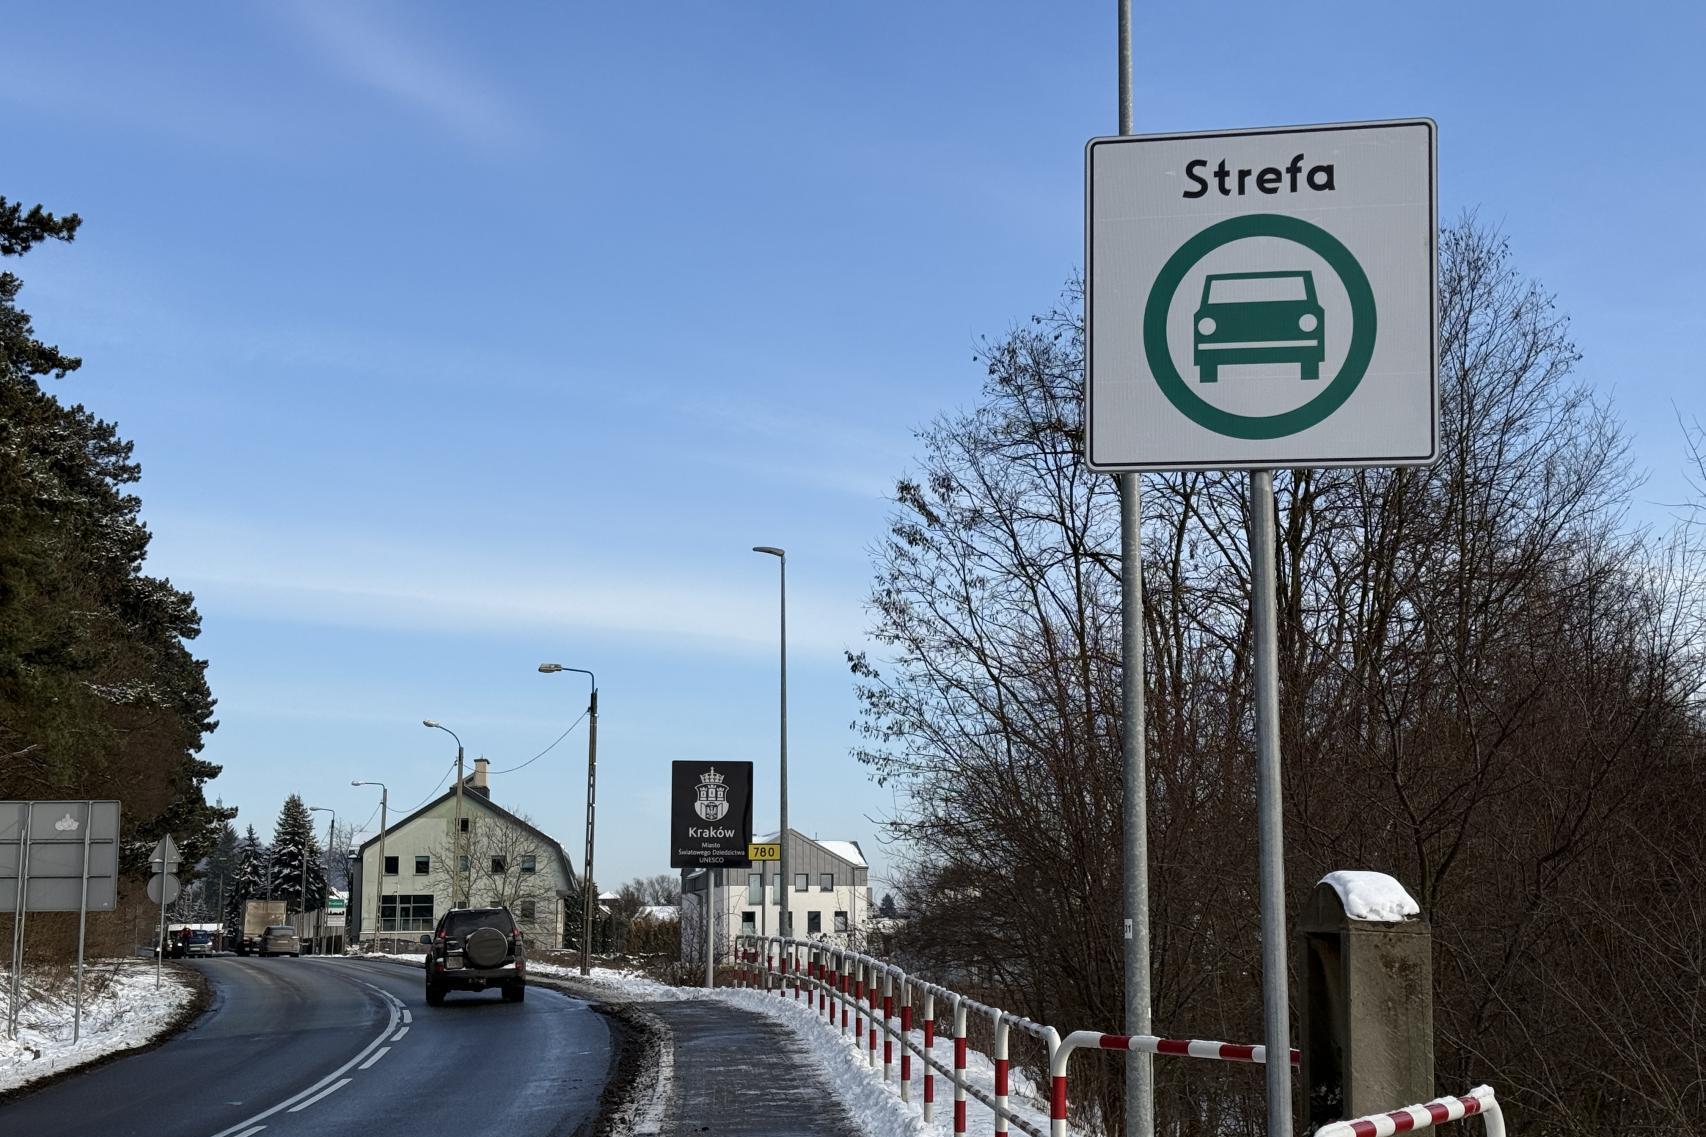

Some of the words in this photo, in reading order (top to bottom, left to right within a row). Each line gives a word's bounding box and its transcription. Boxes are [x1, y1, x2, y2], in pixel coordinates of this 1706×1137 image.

[1182, 153, 1336, 199] Strefa
[688, 826, 735, 838] Kraków
[753, 847, 775, 858] 780
